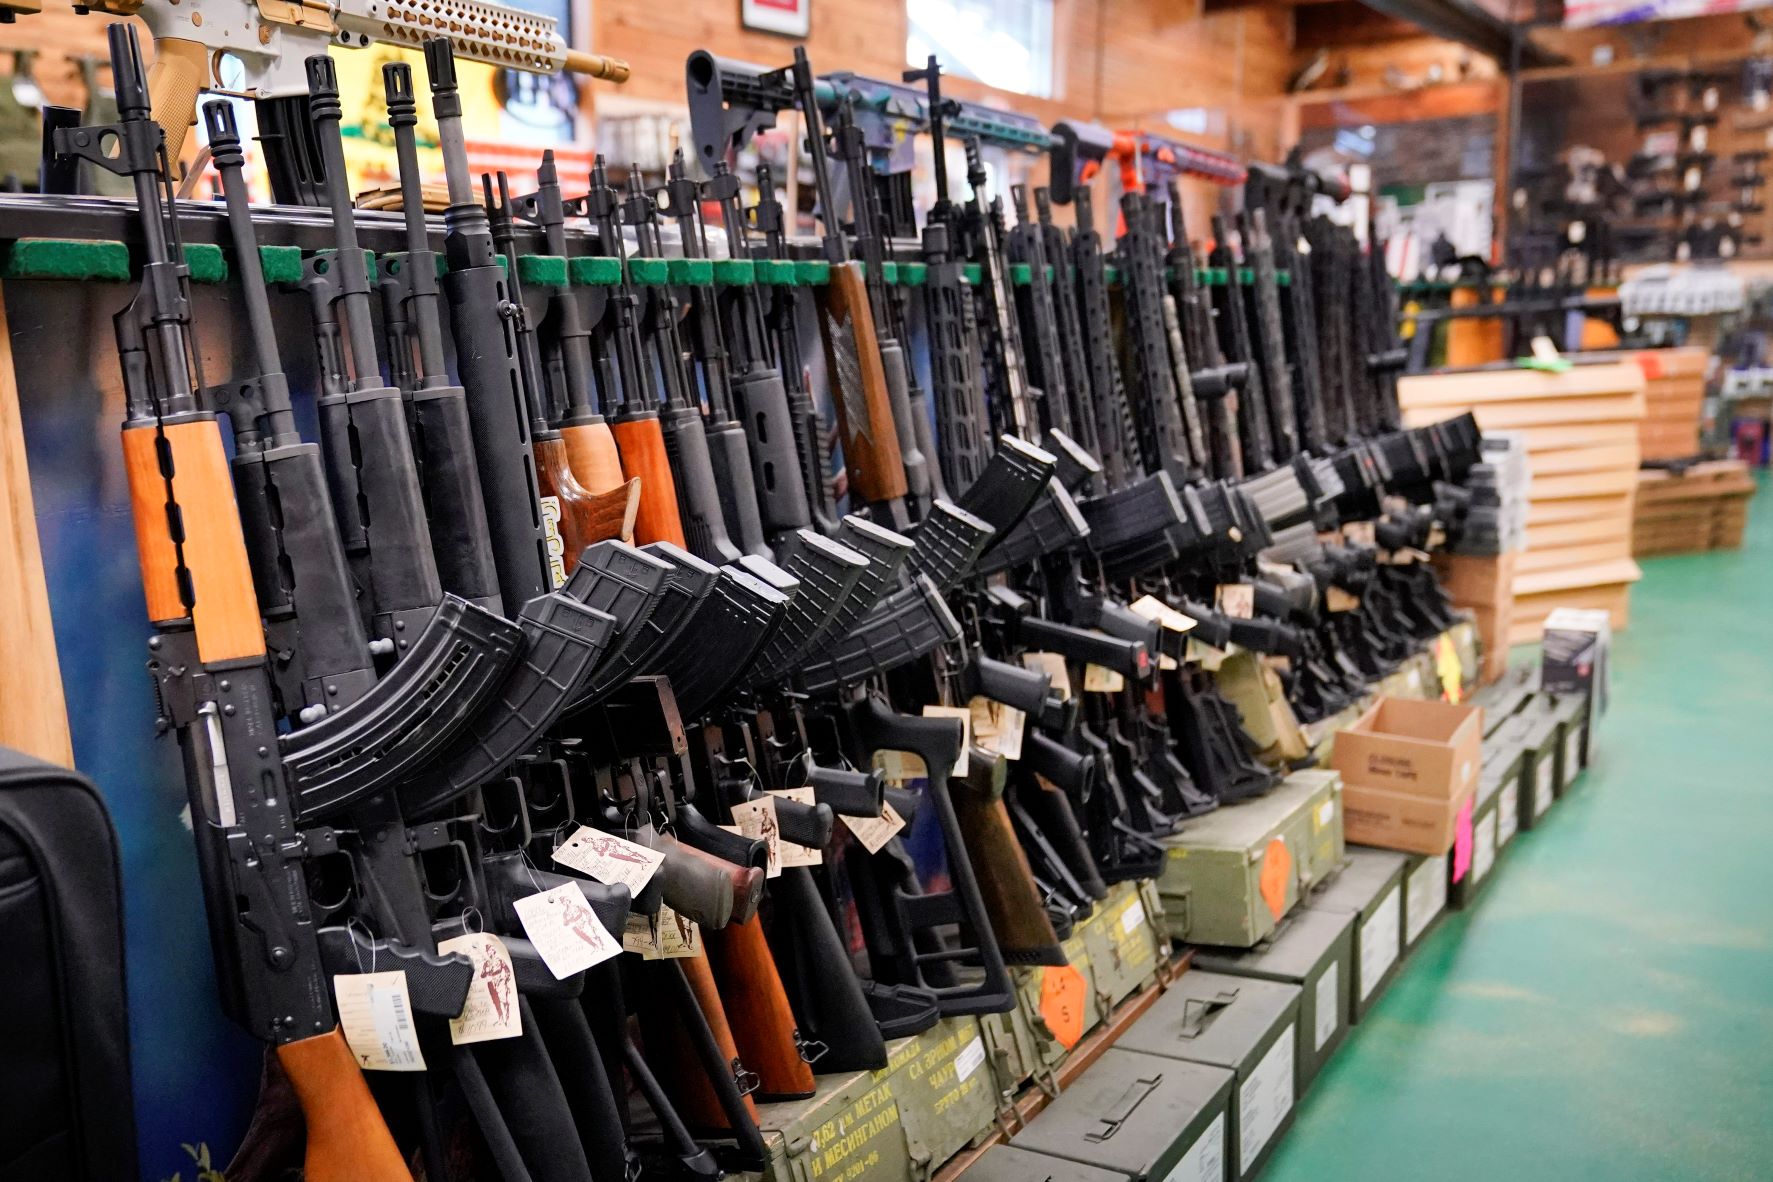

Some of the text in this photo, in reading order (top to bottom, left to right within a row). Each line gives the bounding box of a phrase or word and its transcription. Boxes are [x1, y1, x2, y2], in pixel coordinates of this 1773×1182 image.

[811, 1119, 836, 1149] 7,62
[854, 1081, 893, 1119] МЕТАК
[823, 1103, 899, 1169] МЕСИНГАНОМ
